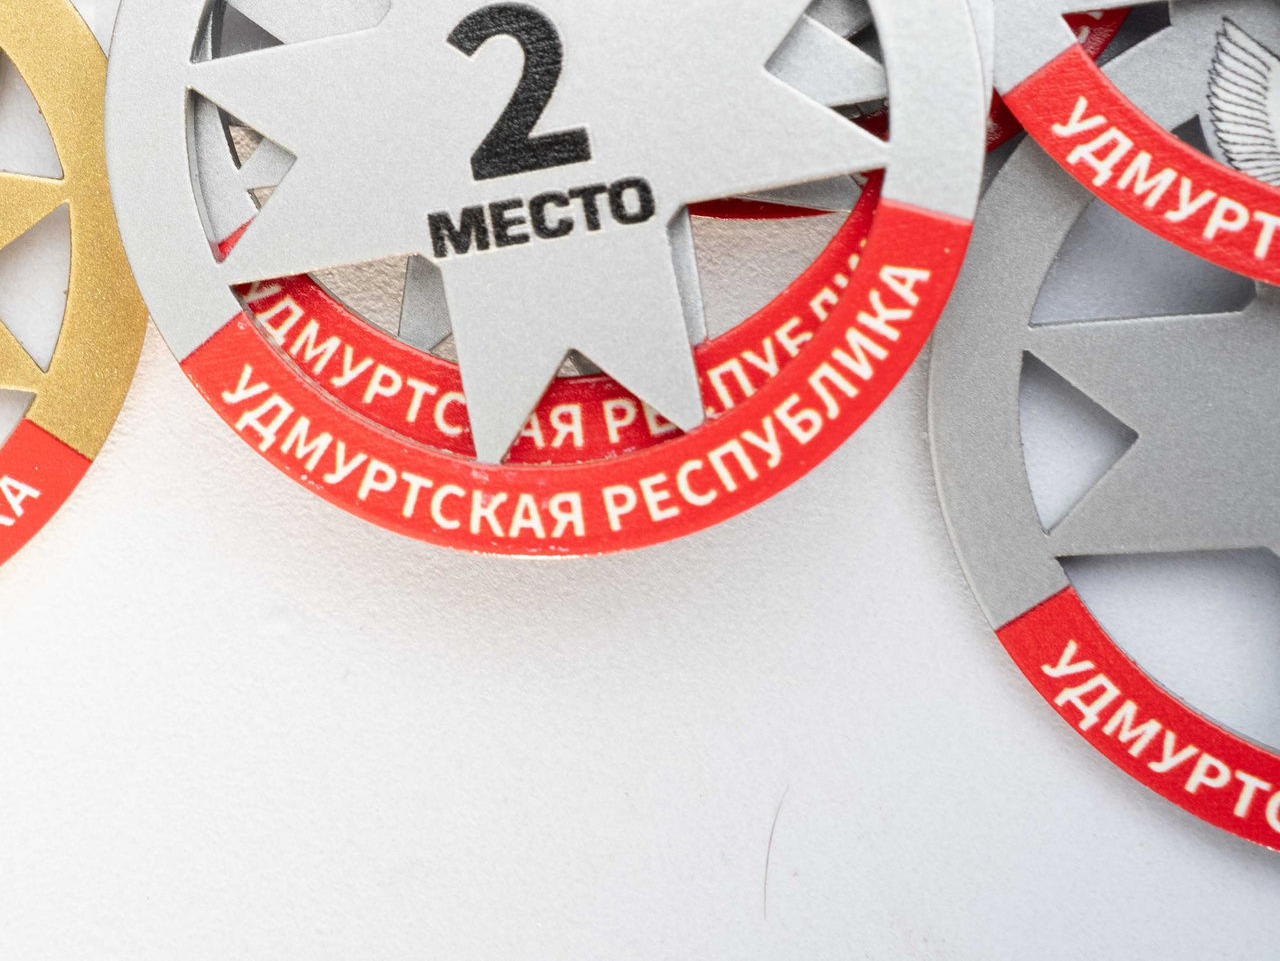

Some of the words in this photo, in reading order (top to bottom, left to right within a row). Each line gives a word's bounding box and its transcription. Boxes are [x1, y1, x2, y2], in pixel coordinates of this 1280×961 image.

[446, 1, 592, 182] 2
[427, 175, 656, 259] МЕСТО
[221, 364, 586, 538] УДМУРТСКАЯ
[601, 265, 931, 532] РЕСПУБЛИКА
